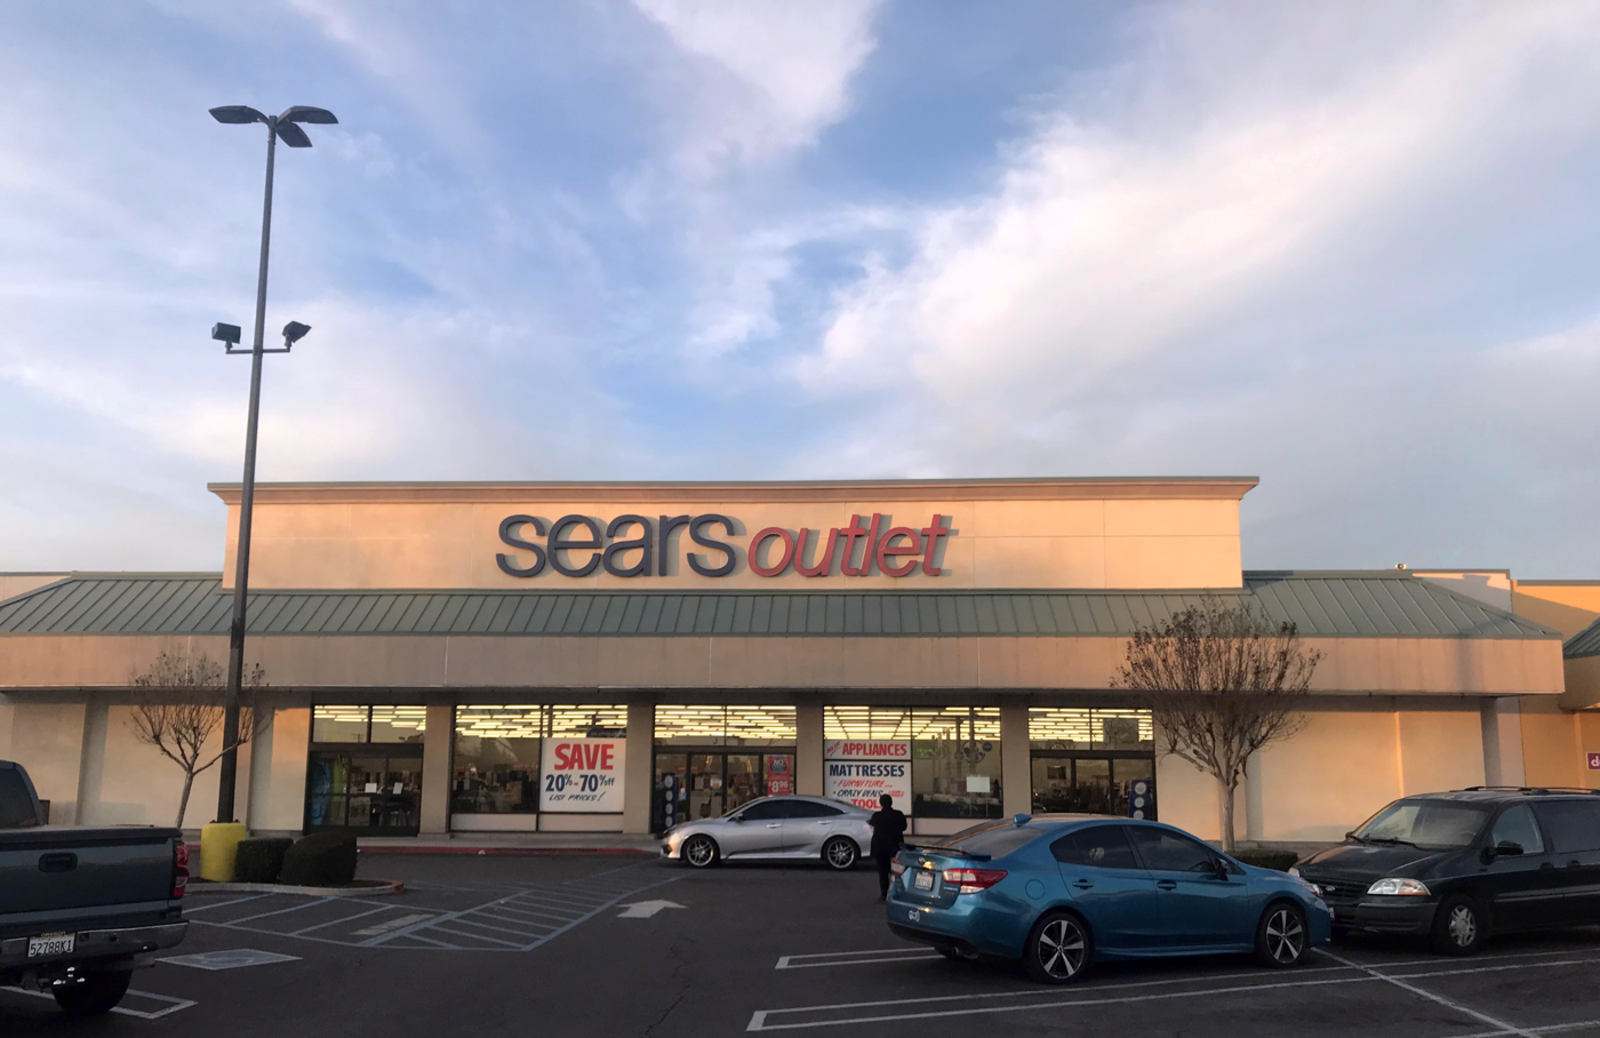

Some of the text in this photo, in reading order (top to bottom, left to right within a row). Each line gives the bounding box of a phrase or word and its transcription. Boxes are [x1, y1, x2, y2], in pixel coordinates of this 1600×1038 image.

[495, 513, 947, 577] sears outlet
[842, 743, 907, 756] APPLIANCES
[554, 743, 614, 771] SAVE
[1590, 755, 1600, 767] d
[829, 764, 905, 777] MATTRESSES
[549, 793, 566, 801] LIST
[837, 789, 861, 797] CRAZY
[30, 939, 73, 955] 52788K1
